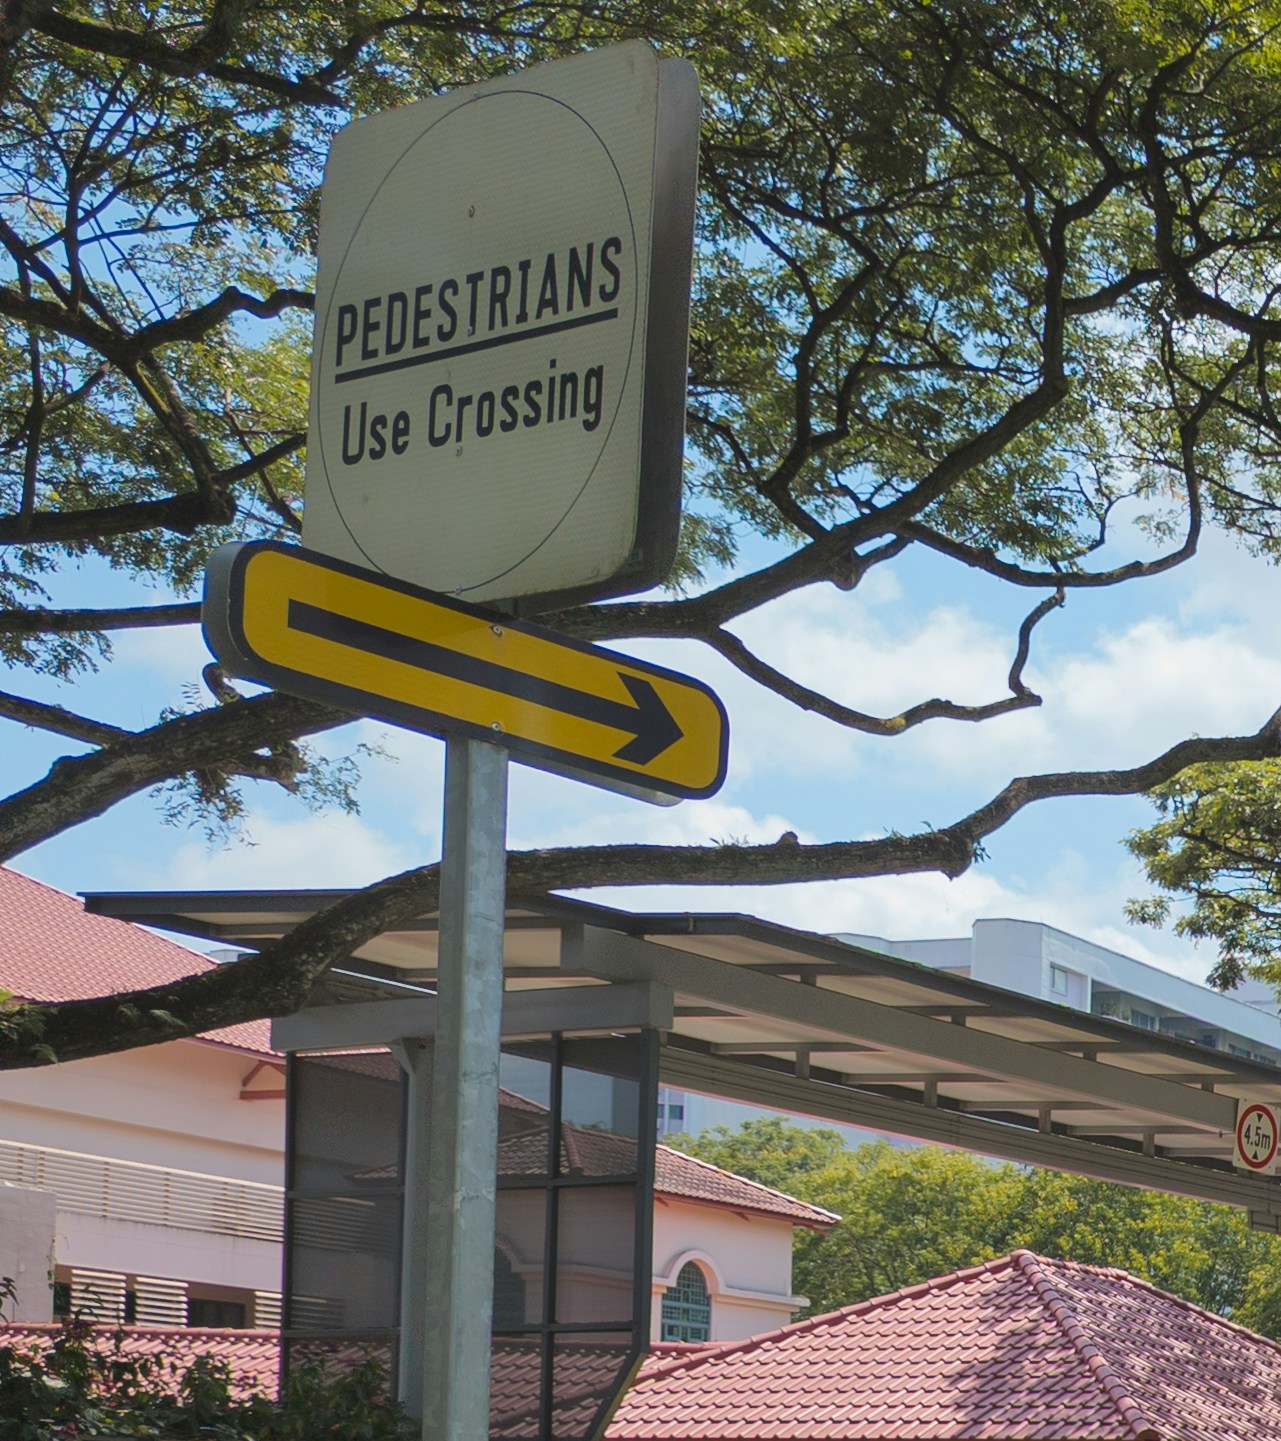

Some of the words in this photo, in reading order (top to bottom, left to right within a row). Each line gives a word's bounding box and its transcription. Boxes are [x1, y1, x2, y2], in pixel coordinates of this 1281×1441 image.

[335, 236, 623, 367] PEDESTRIANS
[341, 402, 411, 466] Use
[427, 359, 605, 450] Crossing
[1244, 1124, 1271, 1150] 4.5m
